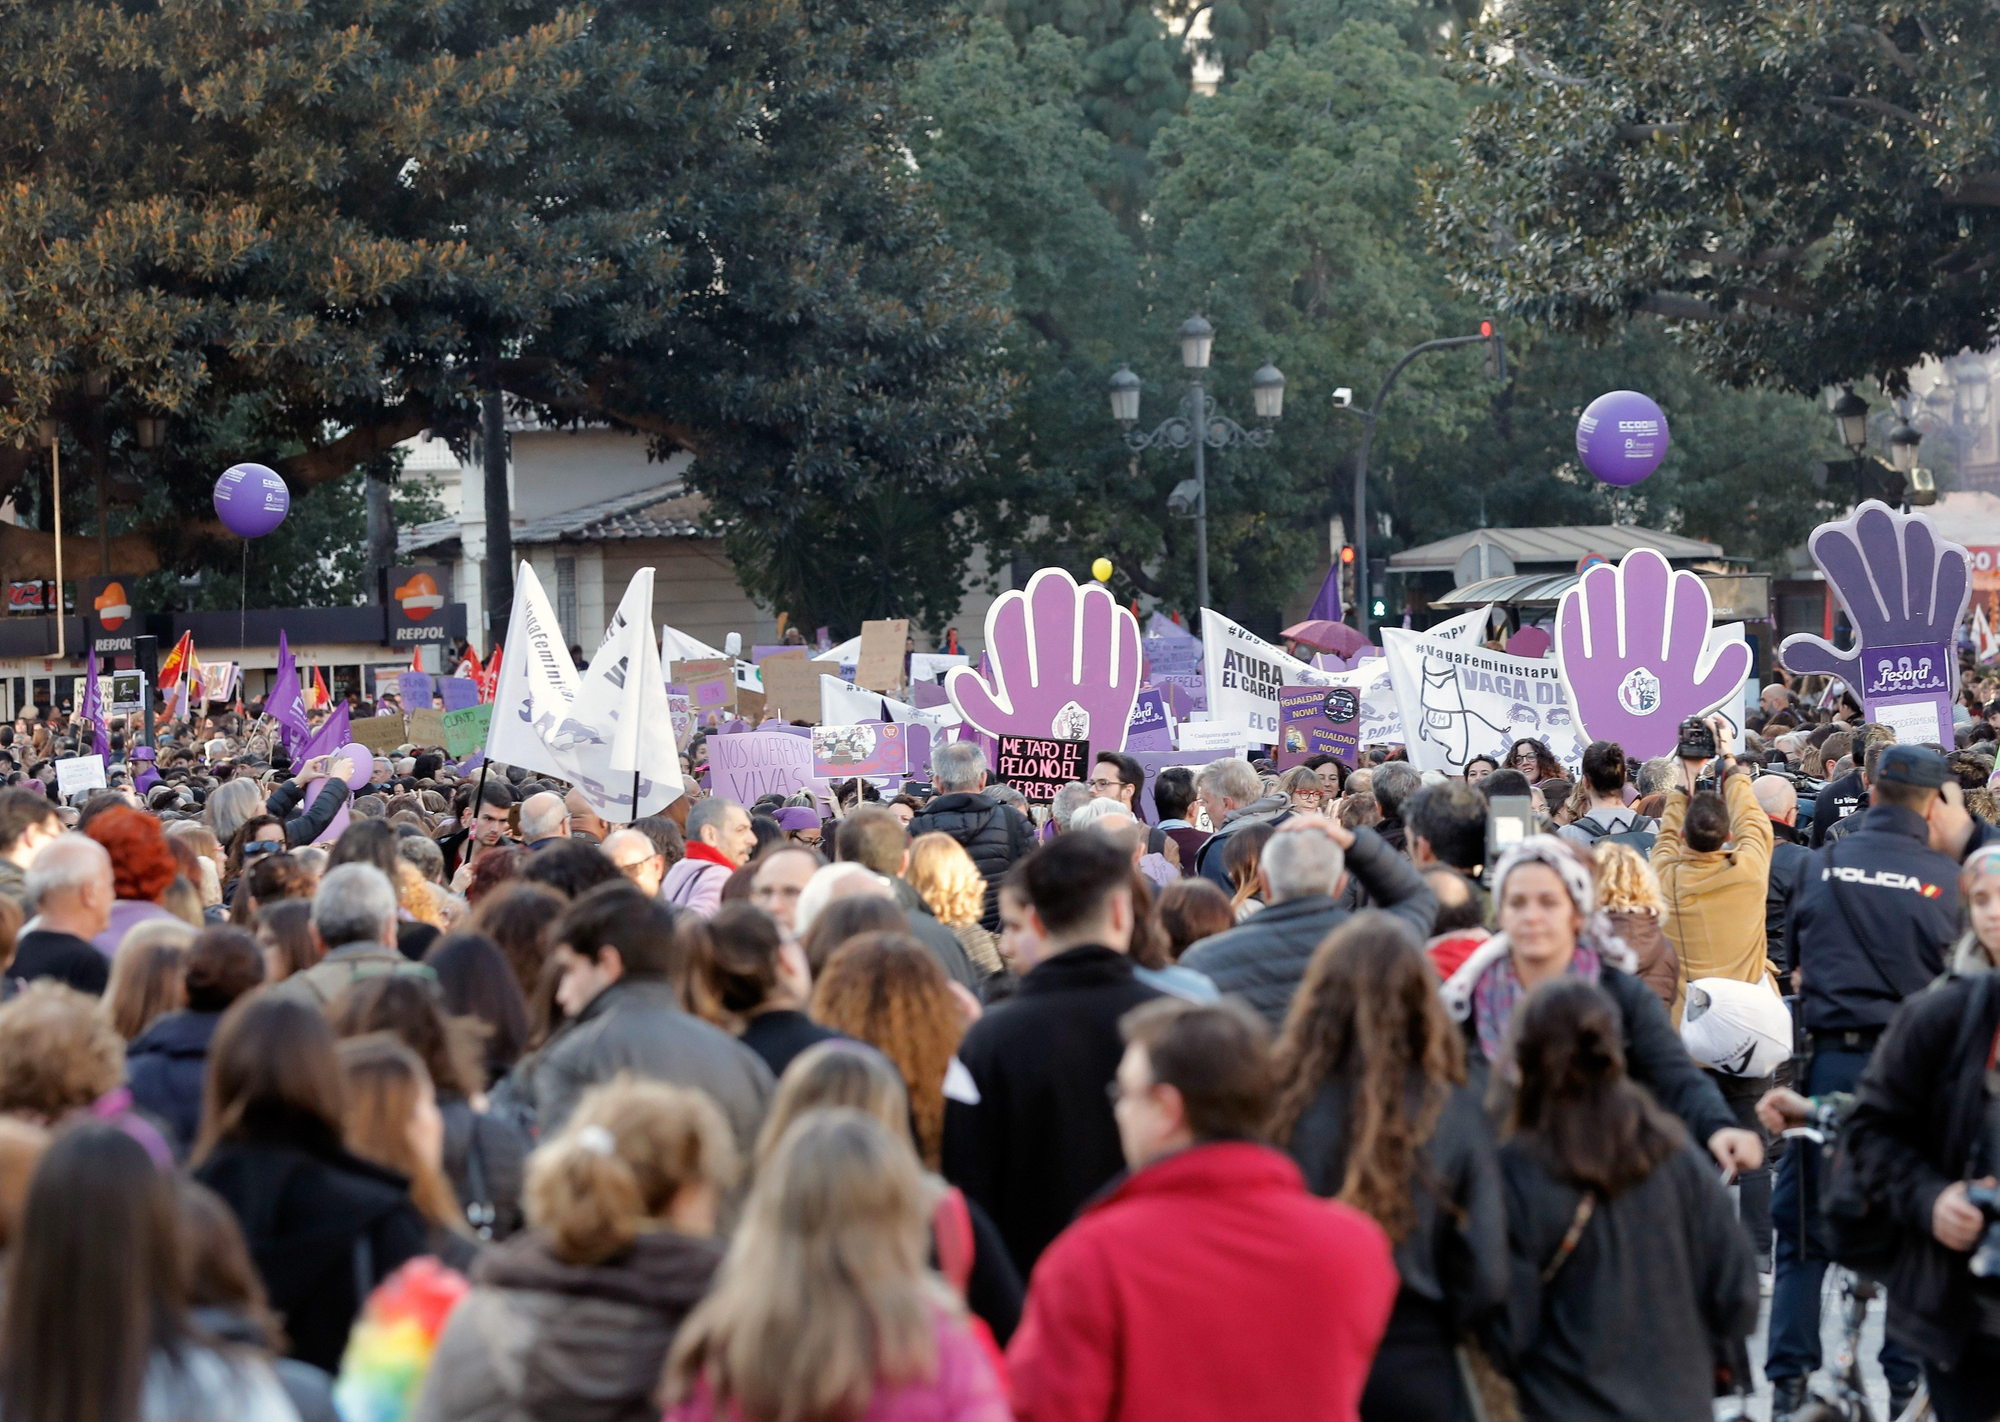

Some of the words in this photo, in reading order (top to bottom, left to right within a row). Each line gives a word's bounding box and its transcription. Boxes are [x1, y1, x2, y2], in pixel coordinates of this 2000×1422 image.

[396, 627, 445, 640] REPSOL
[95, 638, 132, 651] REPSOL
[1223, 648, 1284, 687] ATURA
[1879, 665, 1929, 686] fesord
[1222, 671, 1238, 689] EL
[1462, 668, 1530, 702] VAGA
[1131, 706, 1152, 720] sord
[1249, 711, 1264, 730] EL
[1267, 717, 1279, 732] C
[1292, 707, 1318, 718] NOW!
[1312, 729, 1356, 745] IGUALDAD
[718, 739, 748, 769] NOS
[751, 738, 812, 767] QUEREMOS
[1002, 737, 1024, 756] ME
[1063, 743, 1082, 760] EL
[1319, 743, 1345, 756] NOW!
[1000, 755, 1038, 777] PELO
[1039, 758, 1060, 778] NO
[1062, 761, 1081, 779] EL
[730, 767, 805, 803] VIVAS
[1006, 779, 1066, 799] CEREBR
[1838, 805, 1858, 817] RT
[1821, 866, 1922, 892] POLICIA
